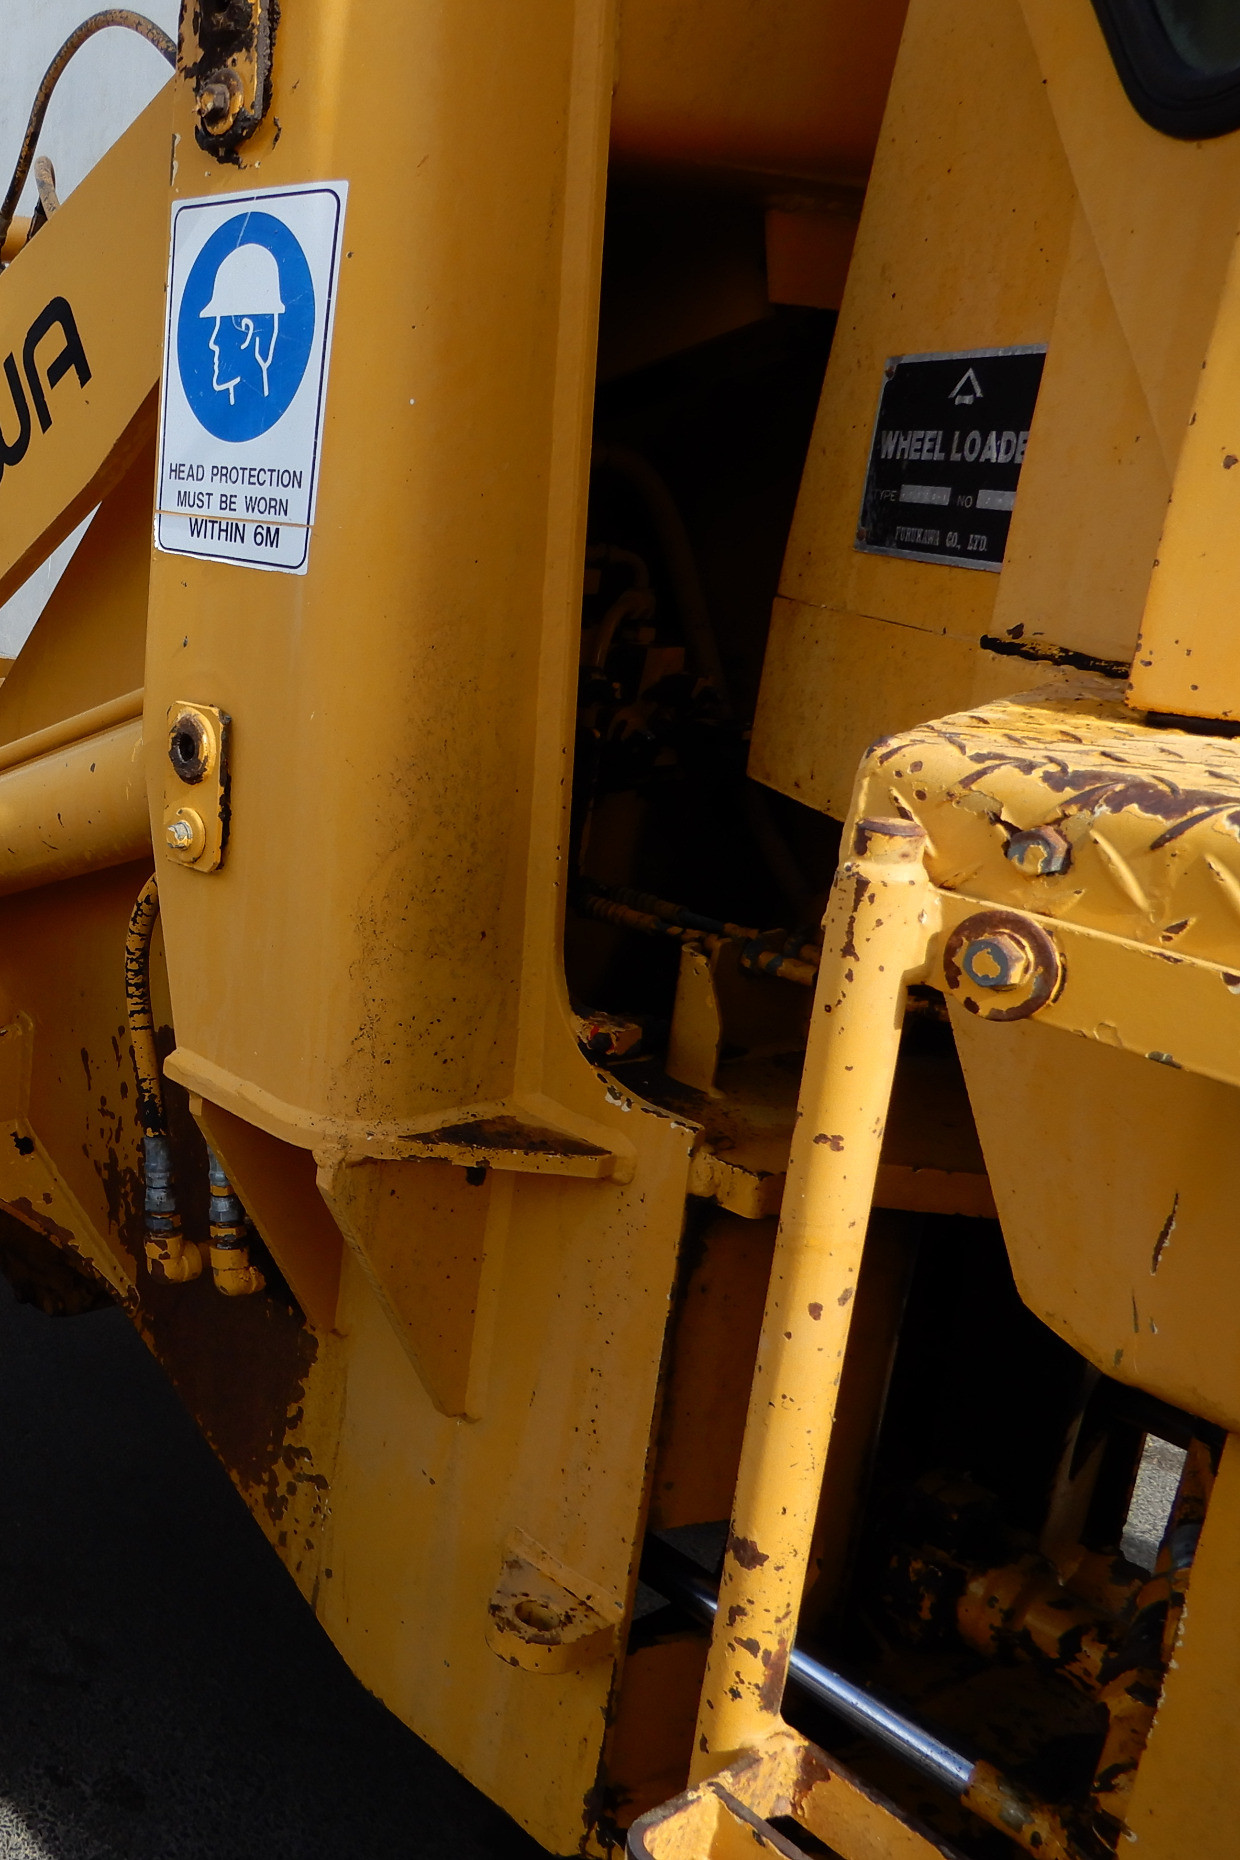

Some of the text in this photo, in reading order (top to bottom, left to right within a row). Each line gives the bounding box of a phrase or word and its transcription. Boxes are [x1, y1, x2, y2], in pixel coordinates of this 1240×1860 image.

[880, 430, 945, 461] WHEEL
[169, 462, 303, 489] HEAD PROTECTION
[177, 490, 289, 517] MUST BE WORN
[189, 517, 280, 549] WITHIN 6M
